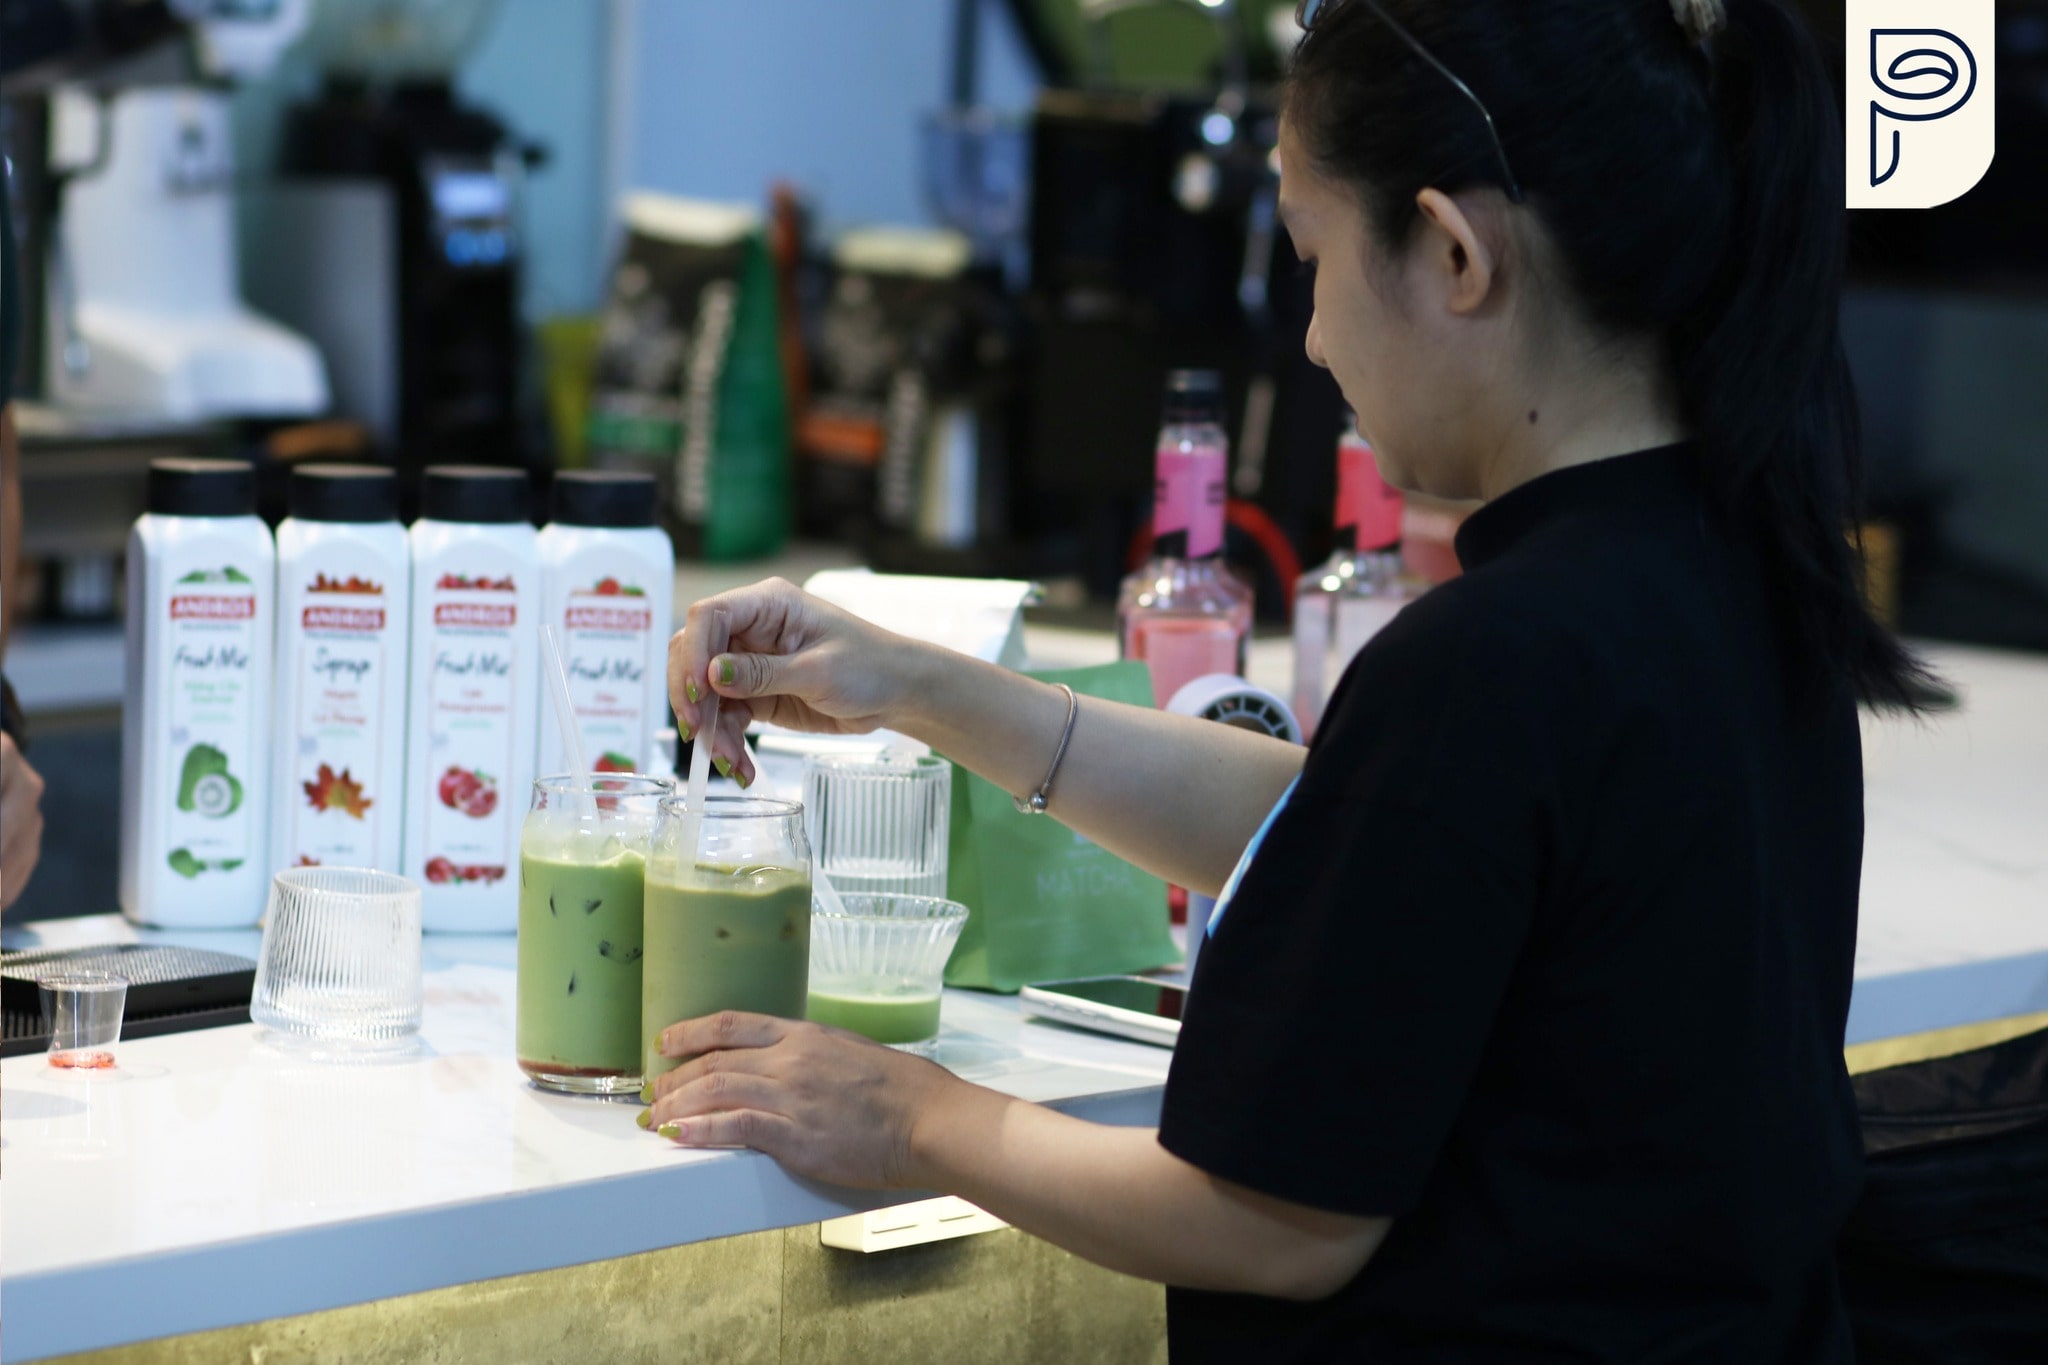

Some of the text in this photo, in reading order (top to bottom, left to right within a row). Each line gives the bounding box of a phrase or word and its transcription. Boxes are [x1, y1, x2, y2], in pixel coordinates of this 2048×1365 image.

[174, 600, 249, 615] ANDROS
[438, 607, 512, 623] ANDROS
[305, 611, 380, 627] ANDROS
[569, 612, 646, 628] ANDROS
